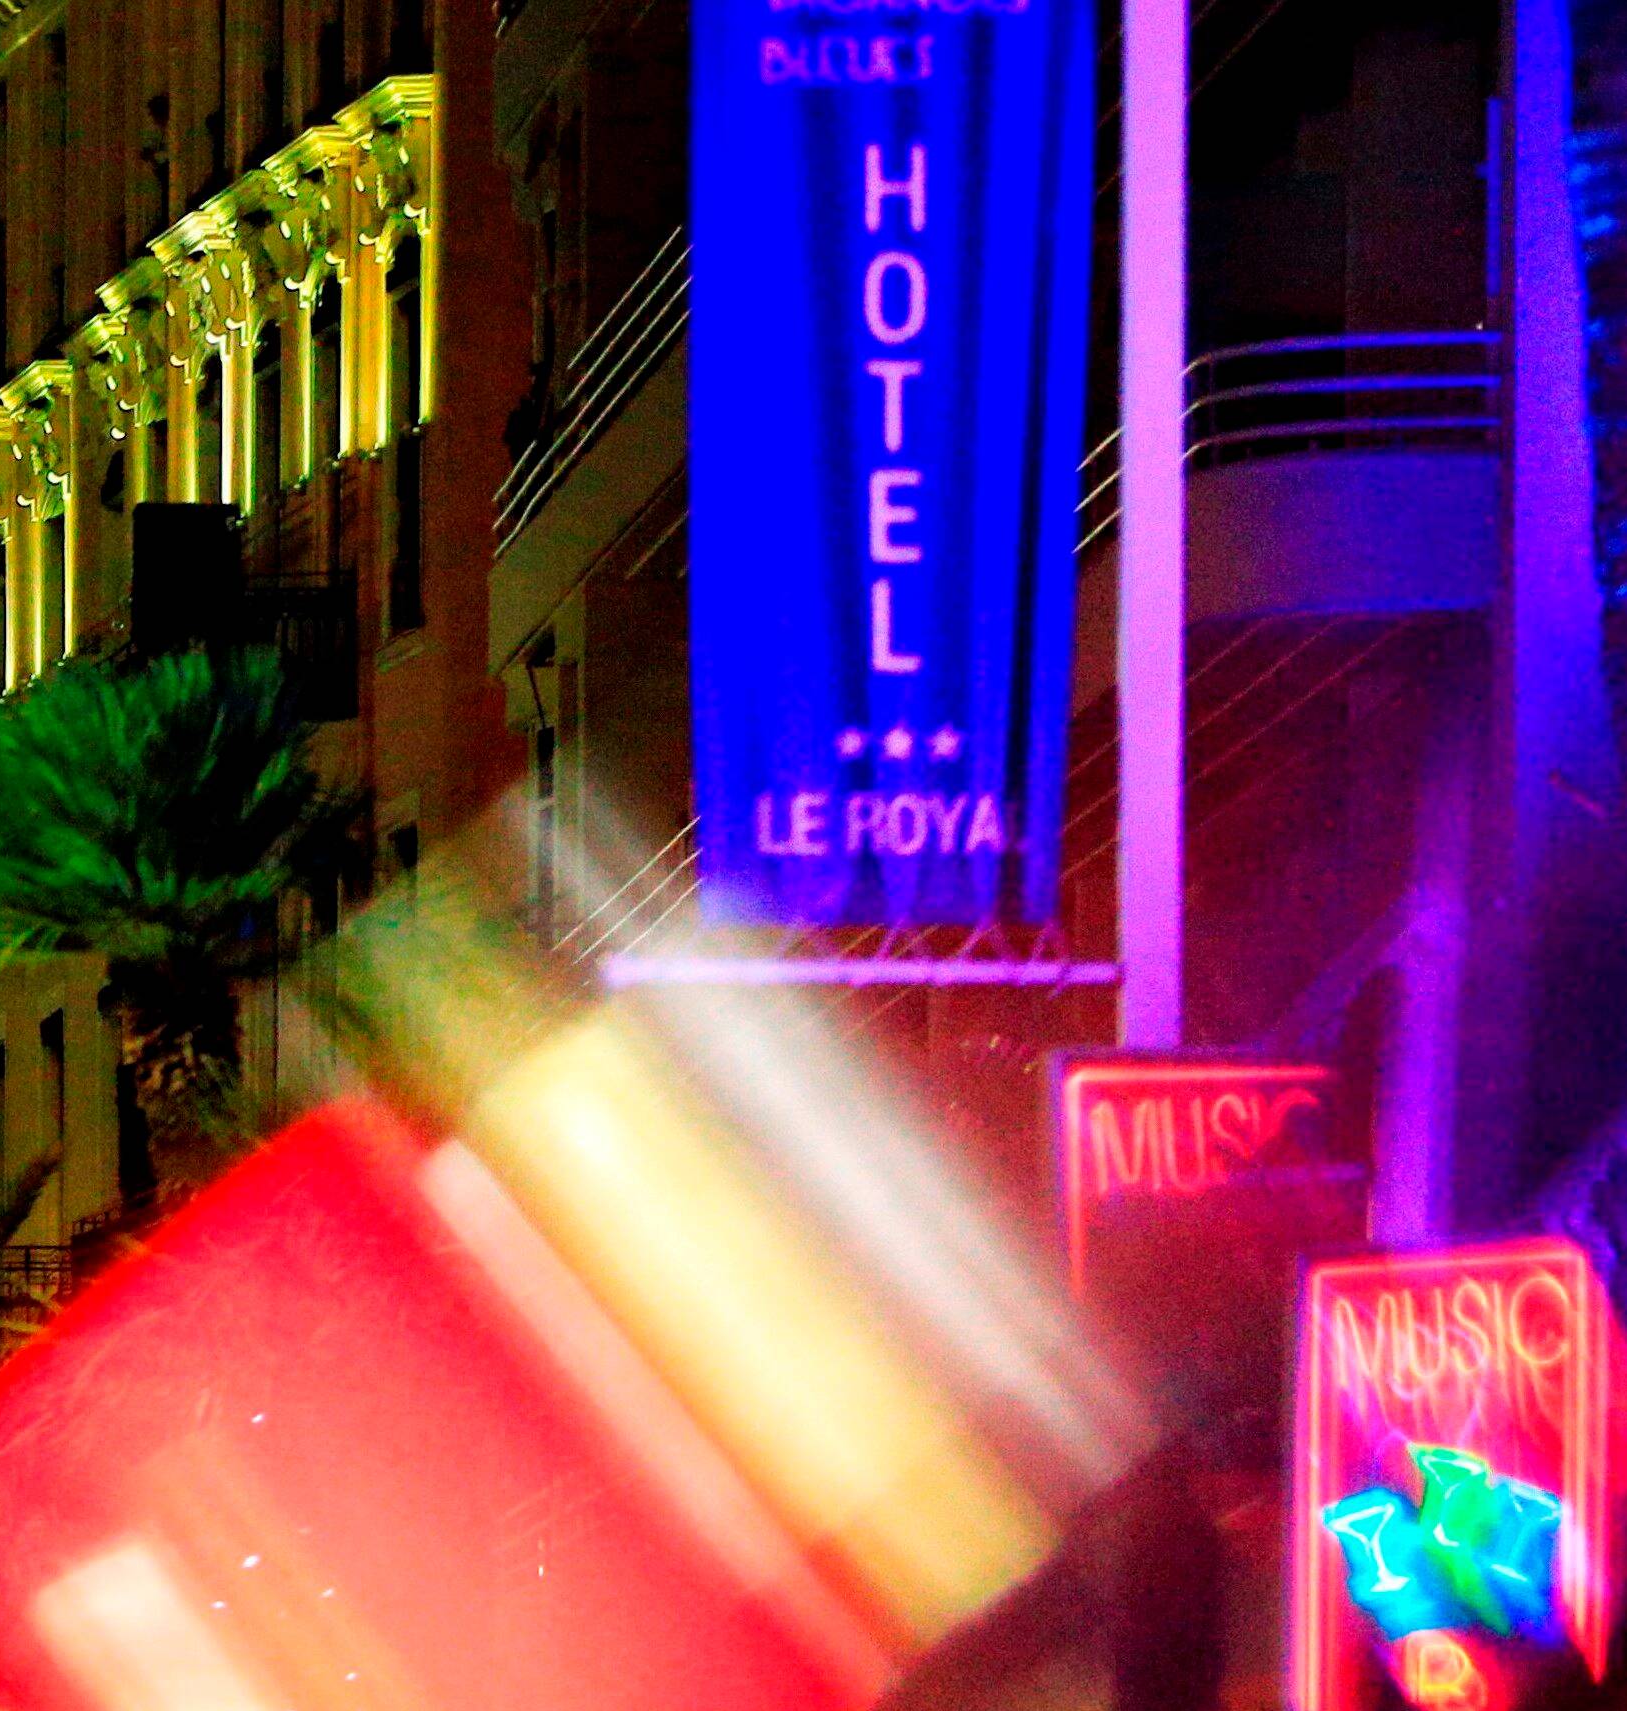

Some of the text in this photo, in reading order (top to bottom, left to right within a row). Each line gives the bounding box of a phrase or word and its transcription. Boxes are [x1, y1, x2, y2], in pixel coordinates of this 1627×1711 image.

[862, 142, 929, 674] HOTEL
[756, 791, 1015, 857] LE ROYA
[1333, 1272, 1572, 1388] MUSIC
